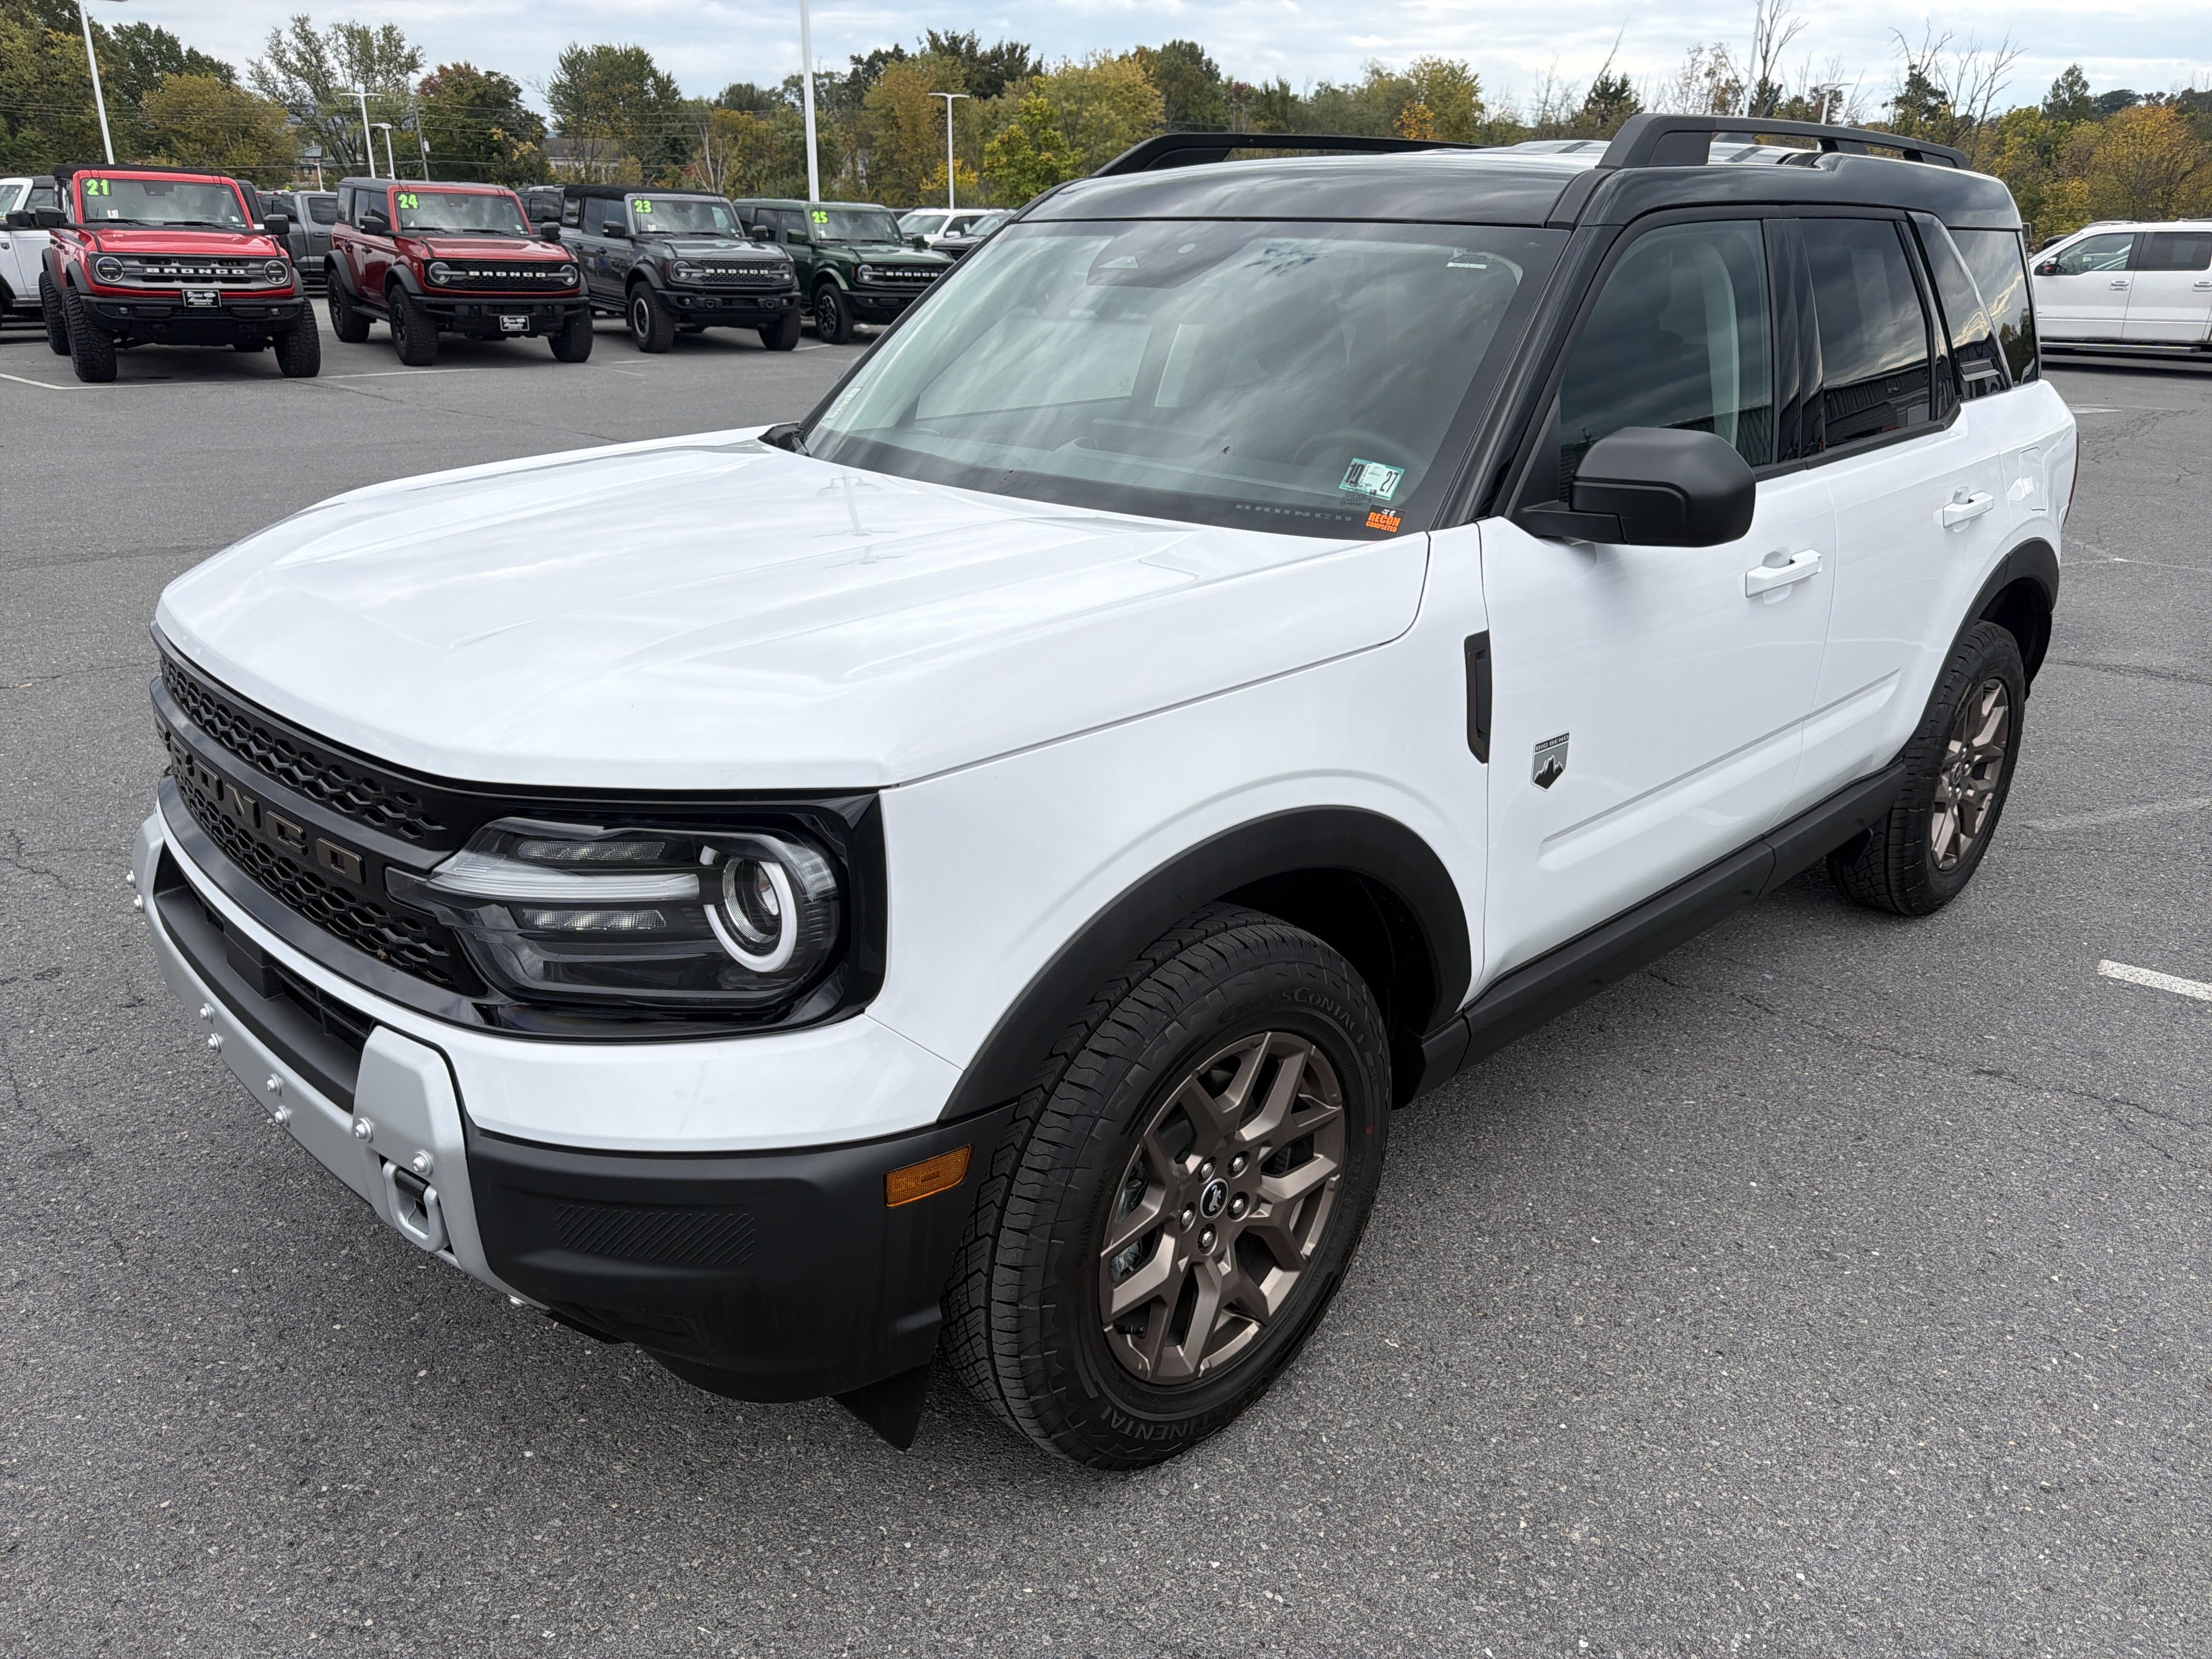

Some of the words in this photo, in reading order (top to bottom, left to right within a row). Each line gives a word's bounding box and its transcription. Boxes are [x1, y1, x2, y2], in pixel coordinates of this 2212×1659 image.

[86, 179, 110, 195] 21
[398, 194, 419, 209] 24
[634, 200, 652, 213] 23
[812, 211, 828, 223] 25
[1379, 471, 1400, 493] 27
[1235, 504, 1352, 521] BRONCO
[1368, 512, 1401, 527] RECON
[1365, 521, 1397, 533] COMPLETED
[1536, 742, 1548, 751] BIG
[1549, 735, 1568, 746] BEND
[155, 712, 366, 884] BRONCO
